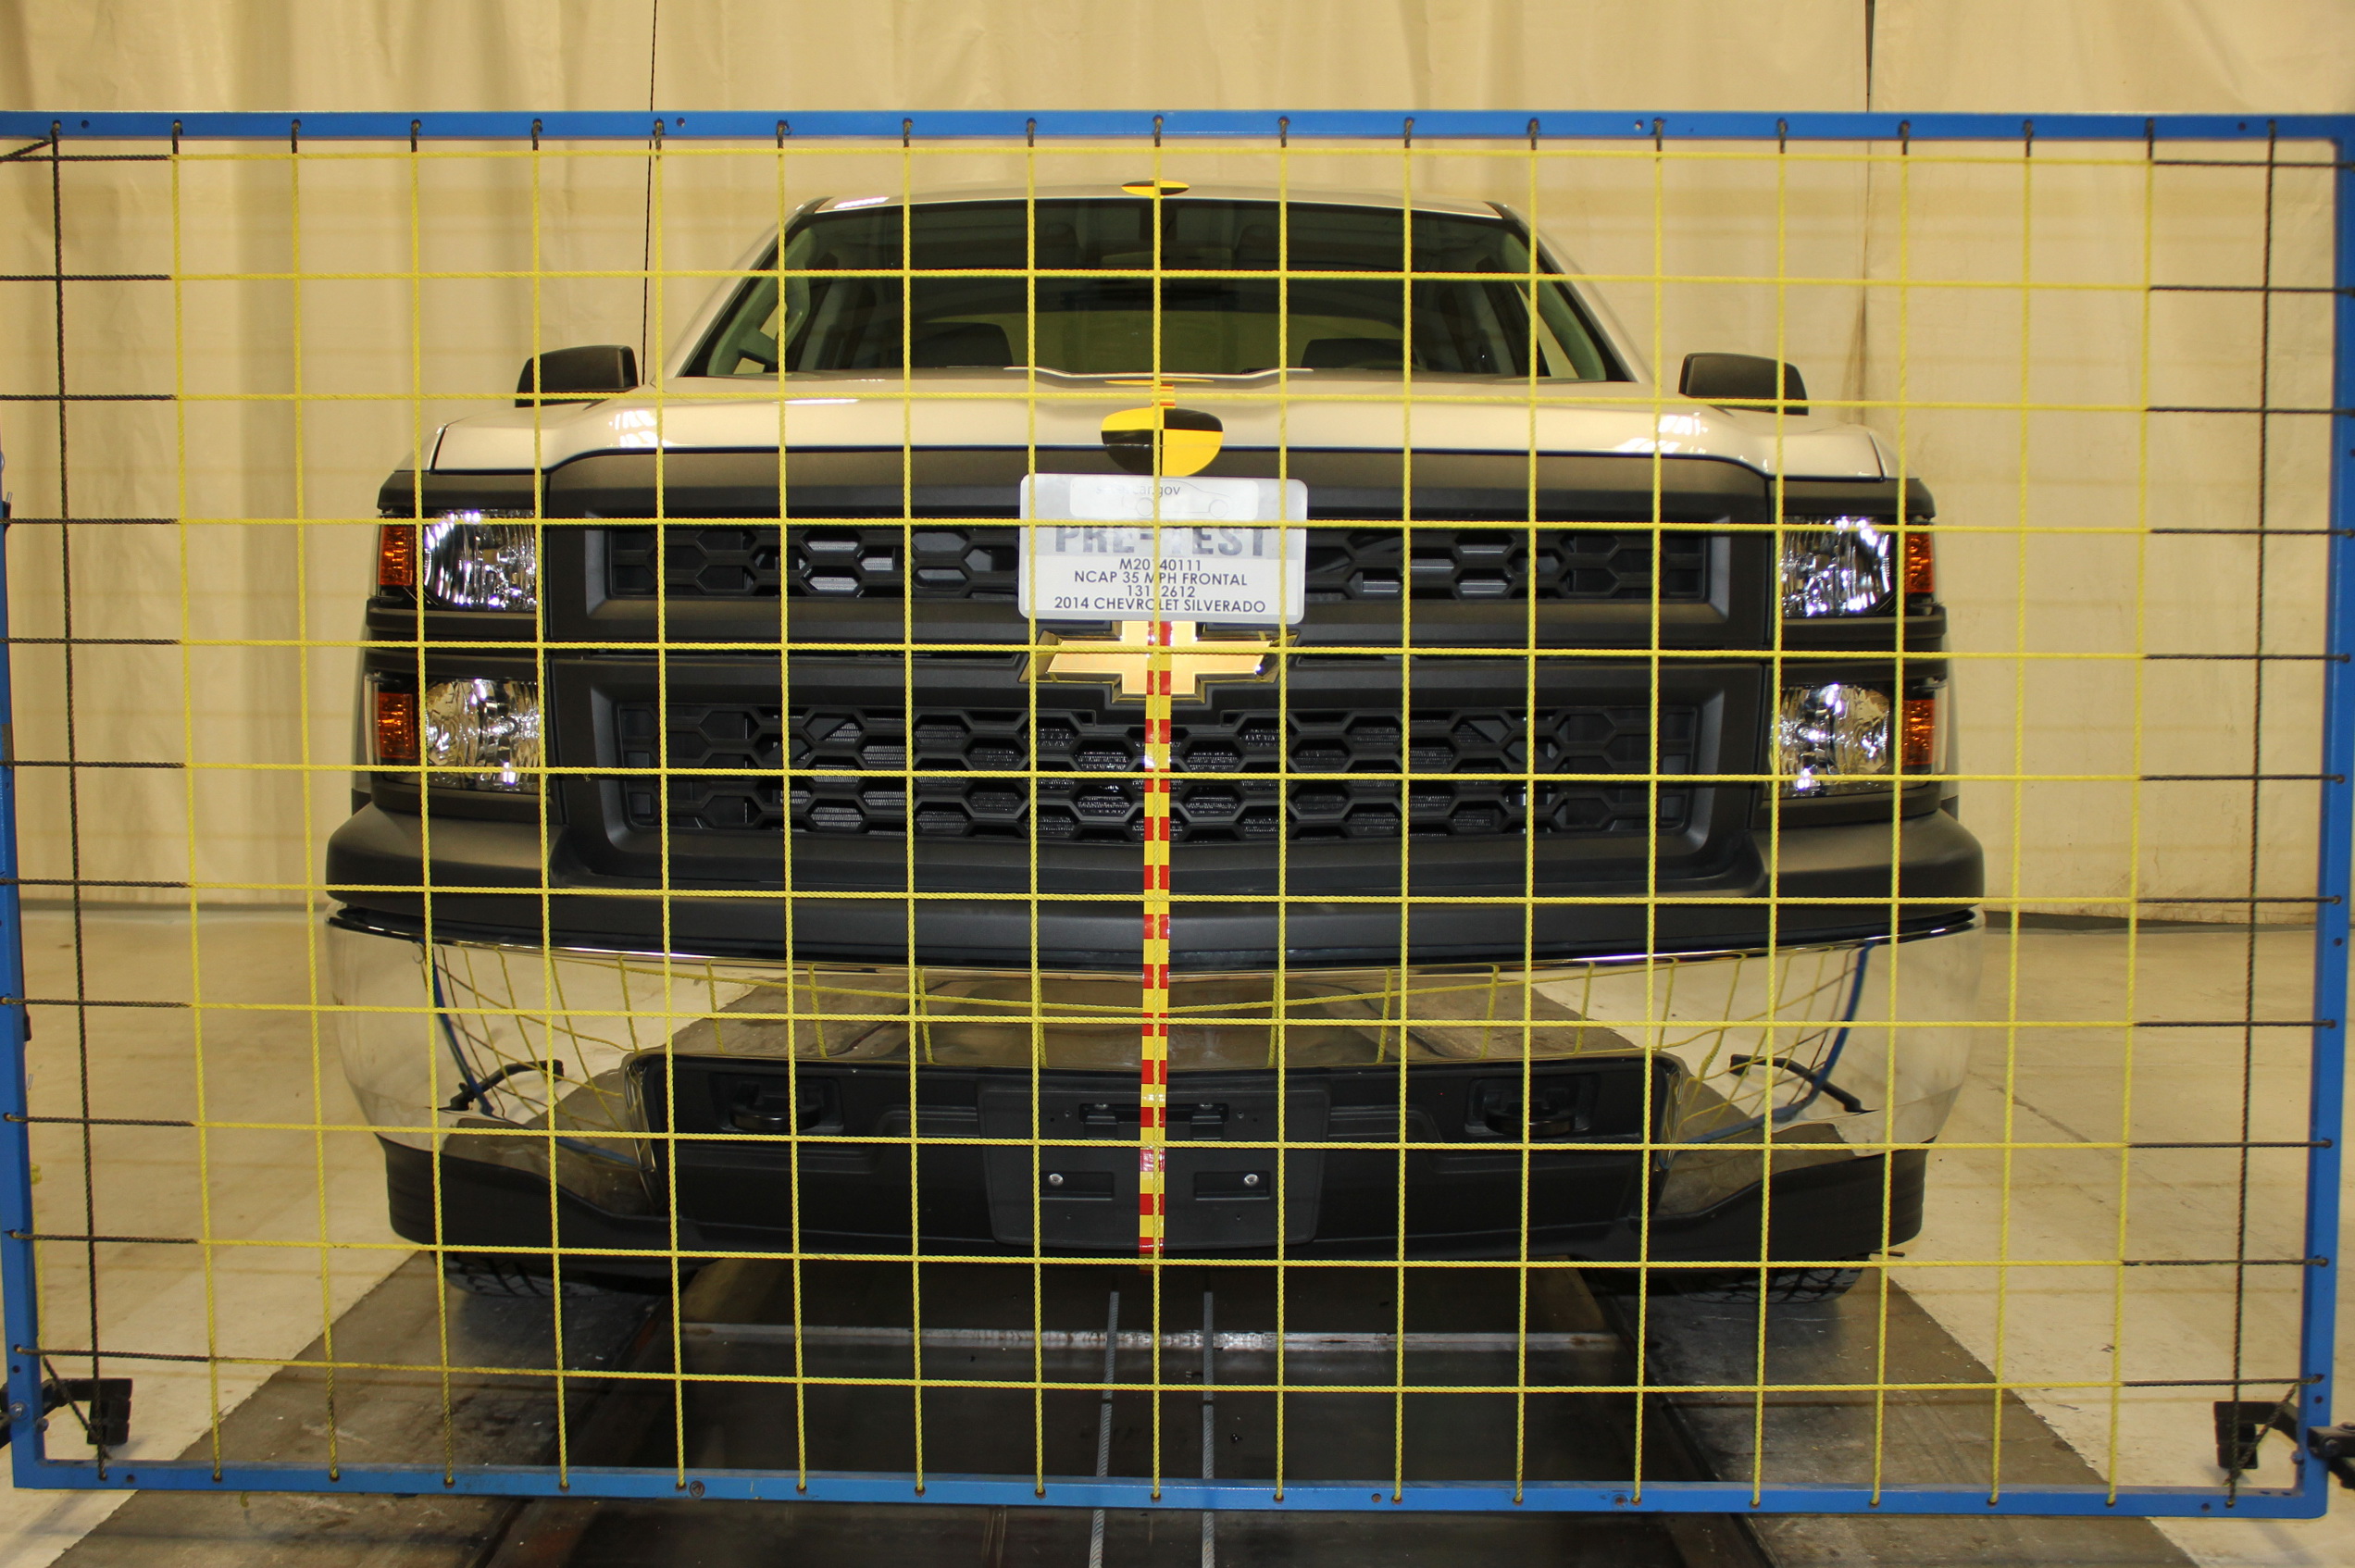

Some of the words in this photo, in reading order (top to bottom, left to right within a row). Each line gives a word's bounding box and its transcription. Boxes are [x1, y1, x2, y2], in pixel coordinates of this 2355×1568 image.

[1119, 558, 1201, 571] M2040111
[1075, 571, 1117, 583] NCAP
[1123, 572, 1140, 583] 35
[1144, 572, 1177, 584] MPH
[1182, 573, 1248, 586] FRONTAL
[1127, 585, 1196, 598] 1312612
[1054, 597, 1090, 609] 2014
[1093, 598, 1178, 611] CHEVROLET
[1184, 600, 1266, 613] SILVERADO
